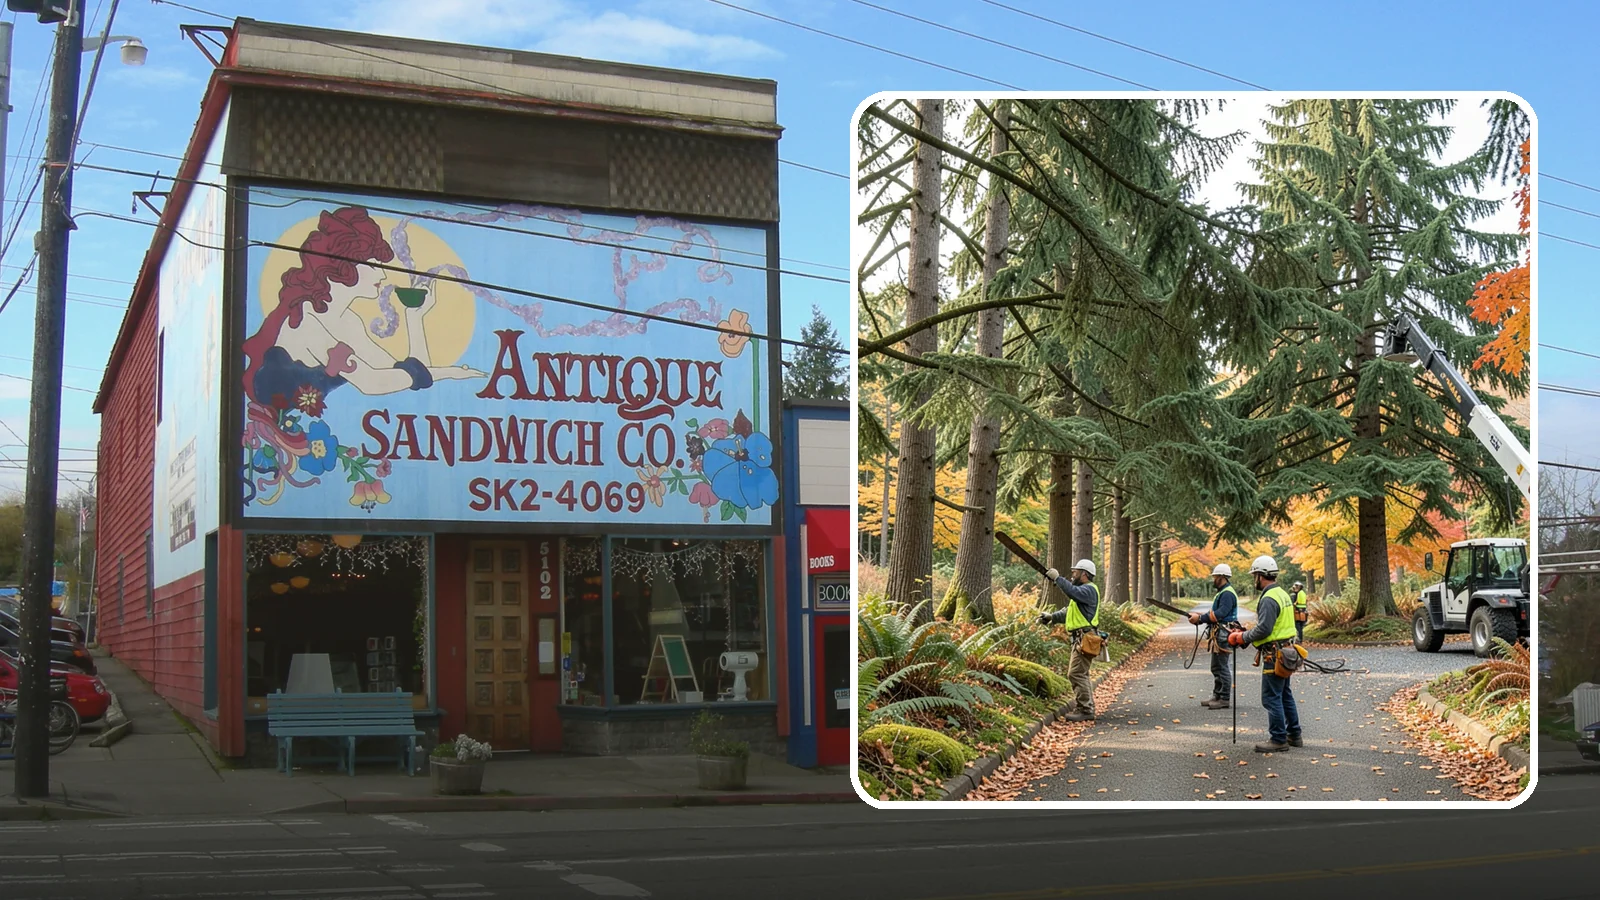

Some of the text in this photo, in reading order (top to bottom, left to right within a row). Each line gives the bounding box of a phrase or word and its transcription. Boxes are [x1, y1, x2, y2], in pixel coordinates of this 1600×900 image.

[475, 329, 723, 420] ANTIQUE
[361, 408, 685, 468] SANDWICH CO.
[468, 477, 645, 513] SK2-4069
[539, 542, 551, 600] 5102
[809, 555, 835, 569] BOOKS
